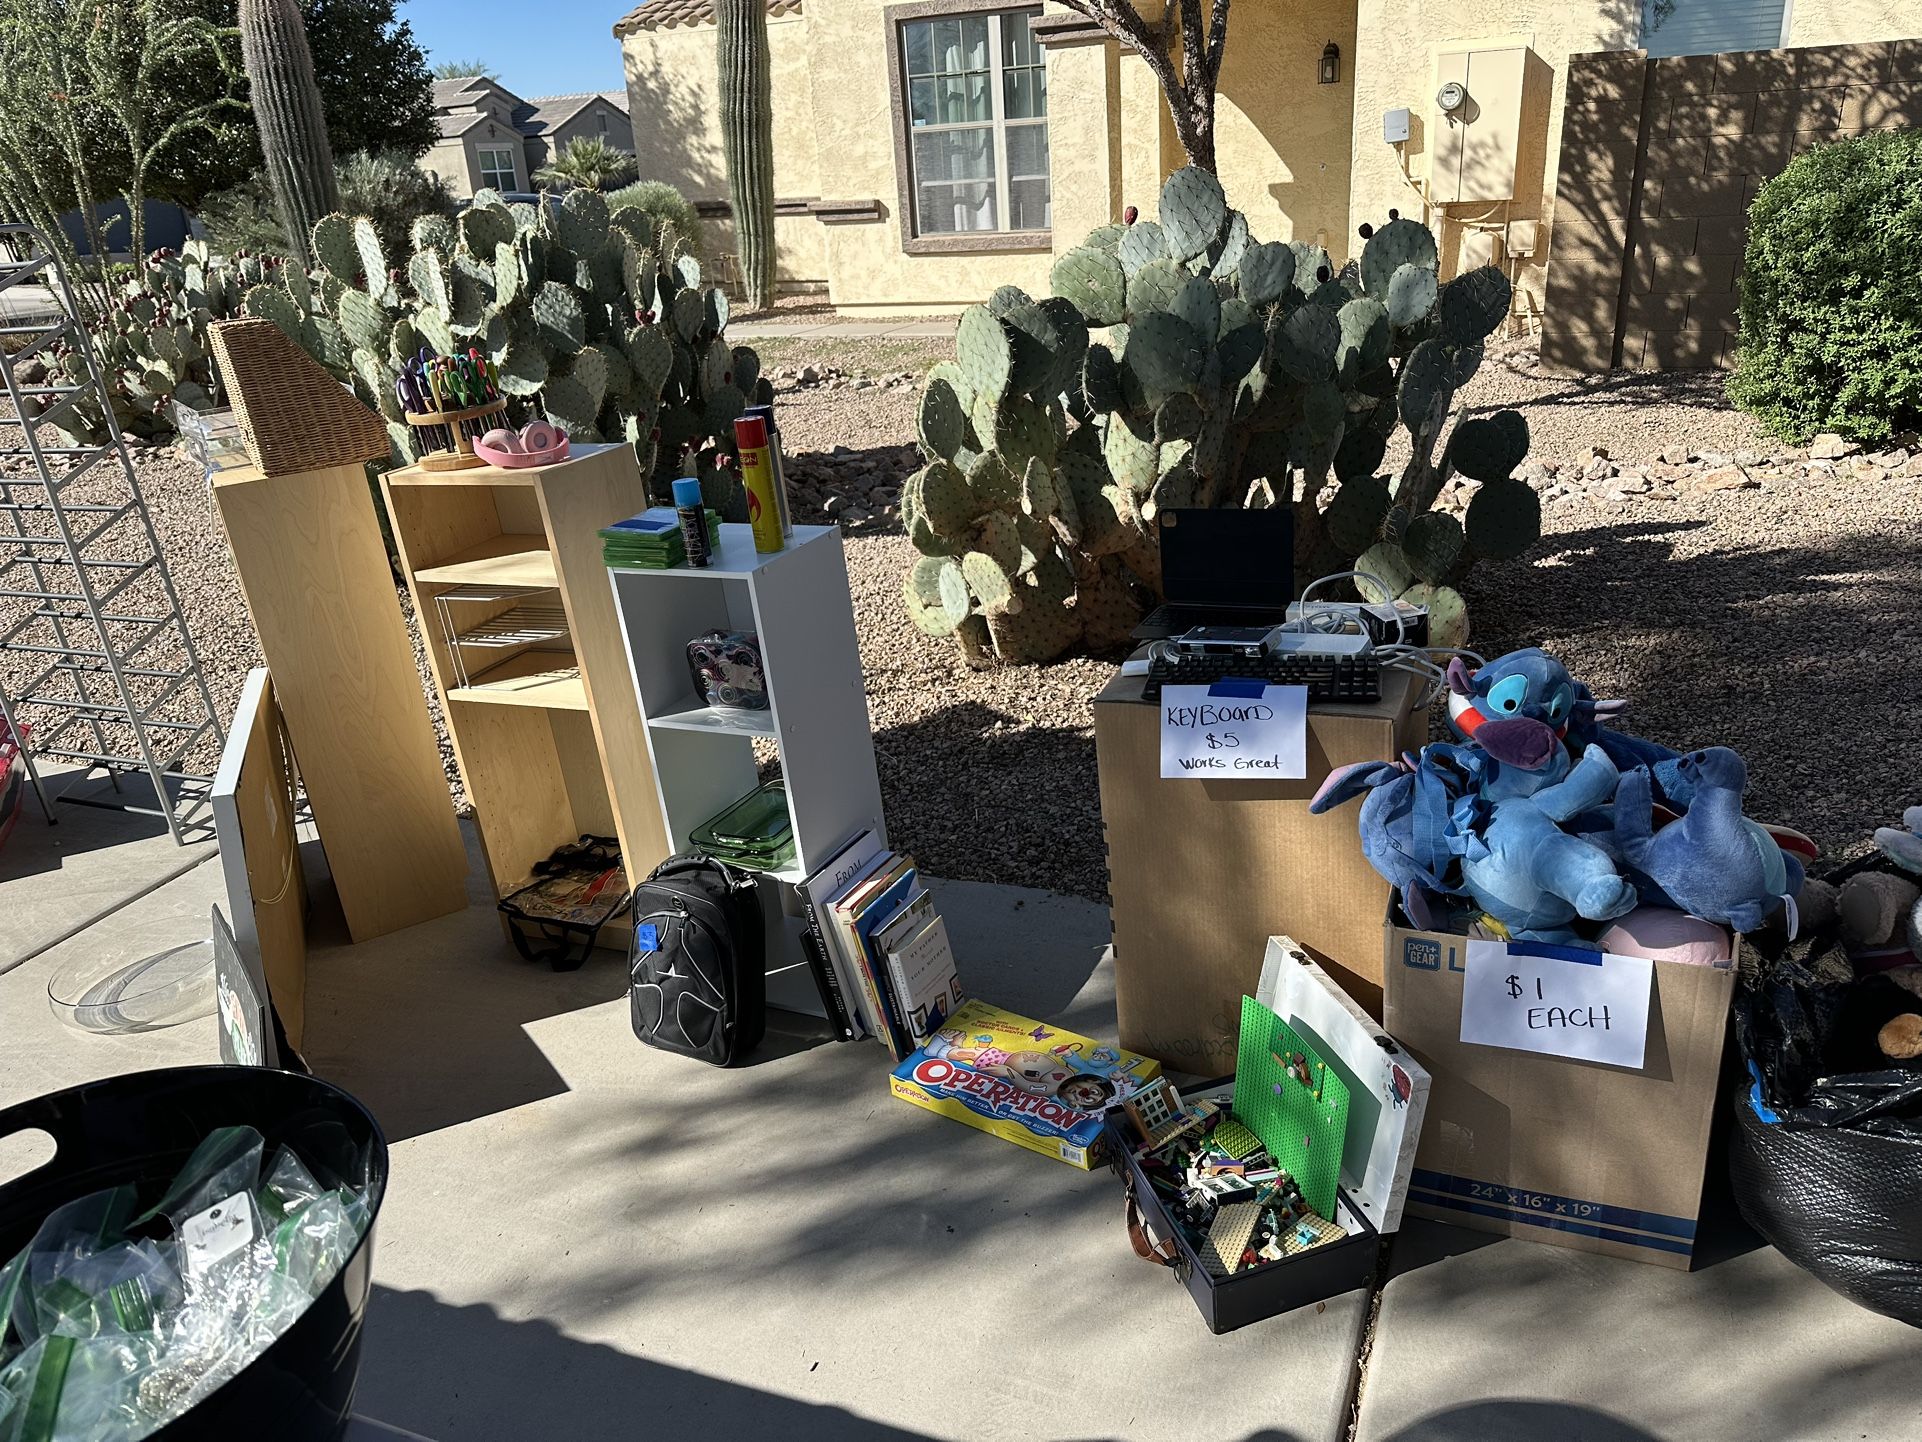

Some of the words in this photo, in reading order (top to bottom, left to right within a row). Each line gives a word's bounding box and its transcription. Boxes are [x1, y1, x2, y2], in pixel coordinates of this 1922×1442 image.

[1205, 732, 1240, 749] $5
[1234, 754, 1283, 770] Great
[835, 858, 862, 888] FROM
[806, 903, 815, 922] FROM
[811, 923, 820, 937] THE
[816, 938, 828, 961] EARTH
[1410, 951, 1436, 966] GEAR
[1527, 1005, 1611, 1030] EACH
[914, 1059, 1090, 1130] OPERATION
[1469, 1184, 1502, 1199] 24"
[1507, 1194, 1518, 1204] x
[1523, 1194, 1551, 1208] 16"
[1555, 1202, 1566, 1213] x
[1572, 1203, 1600, 1217] 19"
